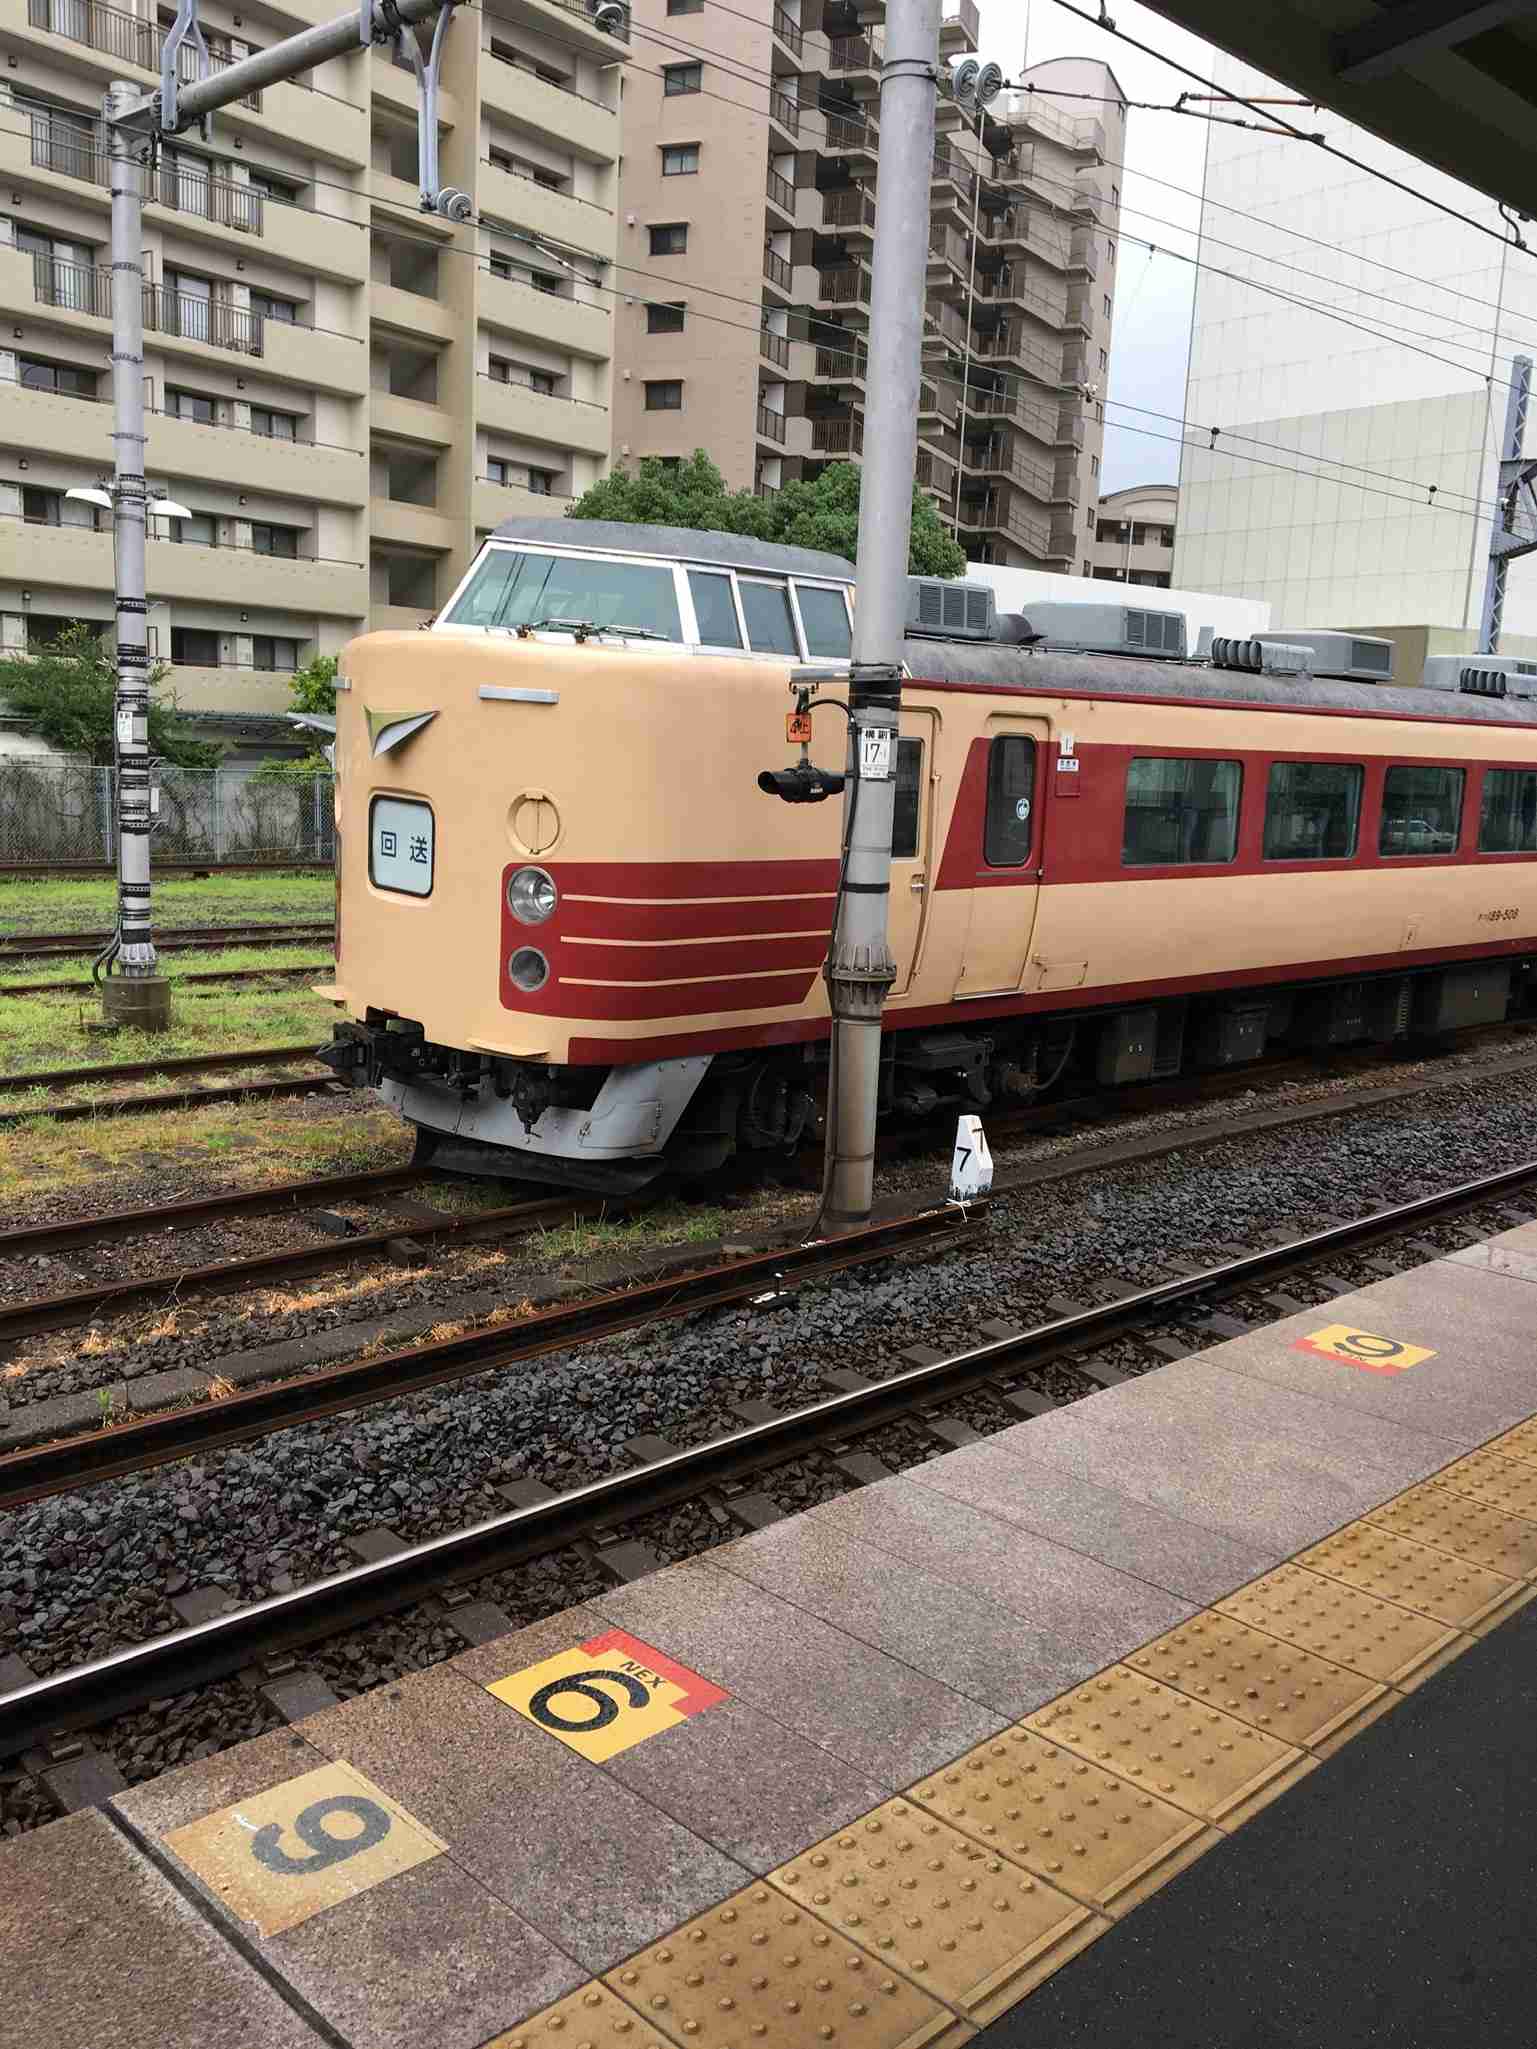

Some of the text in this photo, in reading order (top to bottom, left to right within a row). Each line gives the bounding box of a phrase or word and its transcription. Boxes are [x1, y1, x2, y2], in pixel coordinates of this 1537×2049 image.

[380, 831, 428, 864] 回送
[956, 1146, 972, 1173] 7
[618, 1660, 668, 1690] NEX
[529, 1669, 650, 1732] 6
